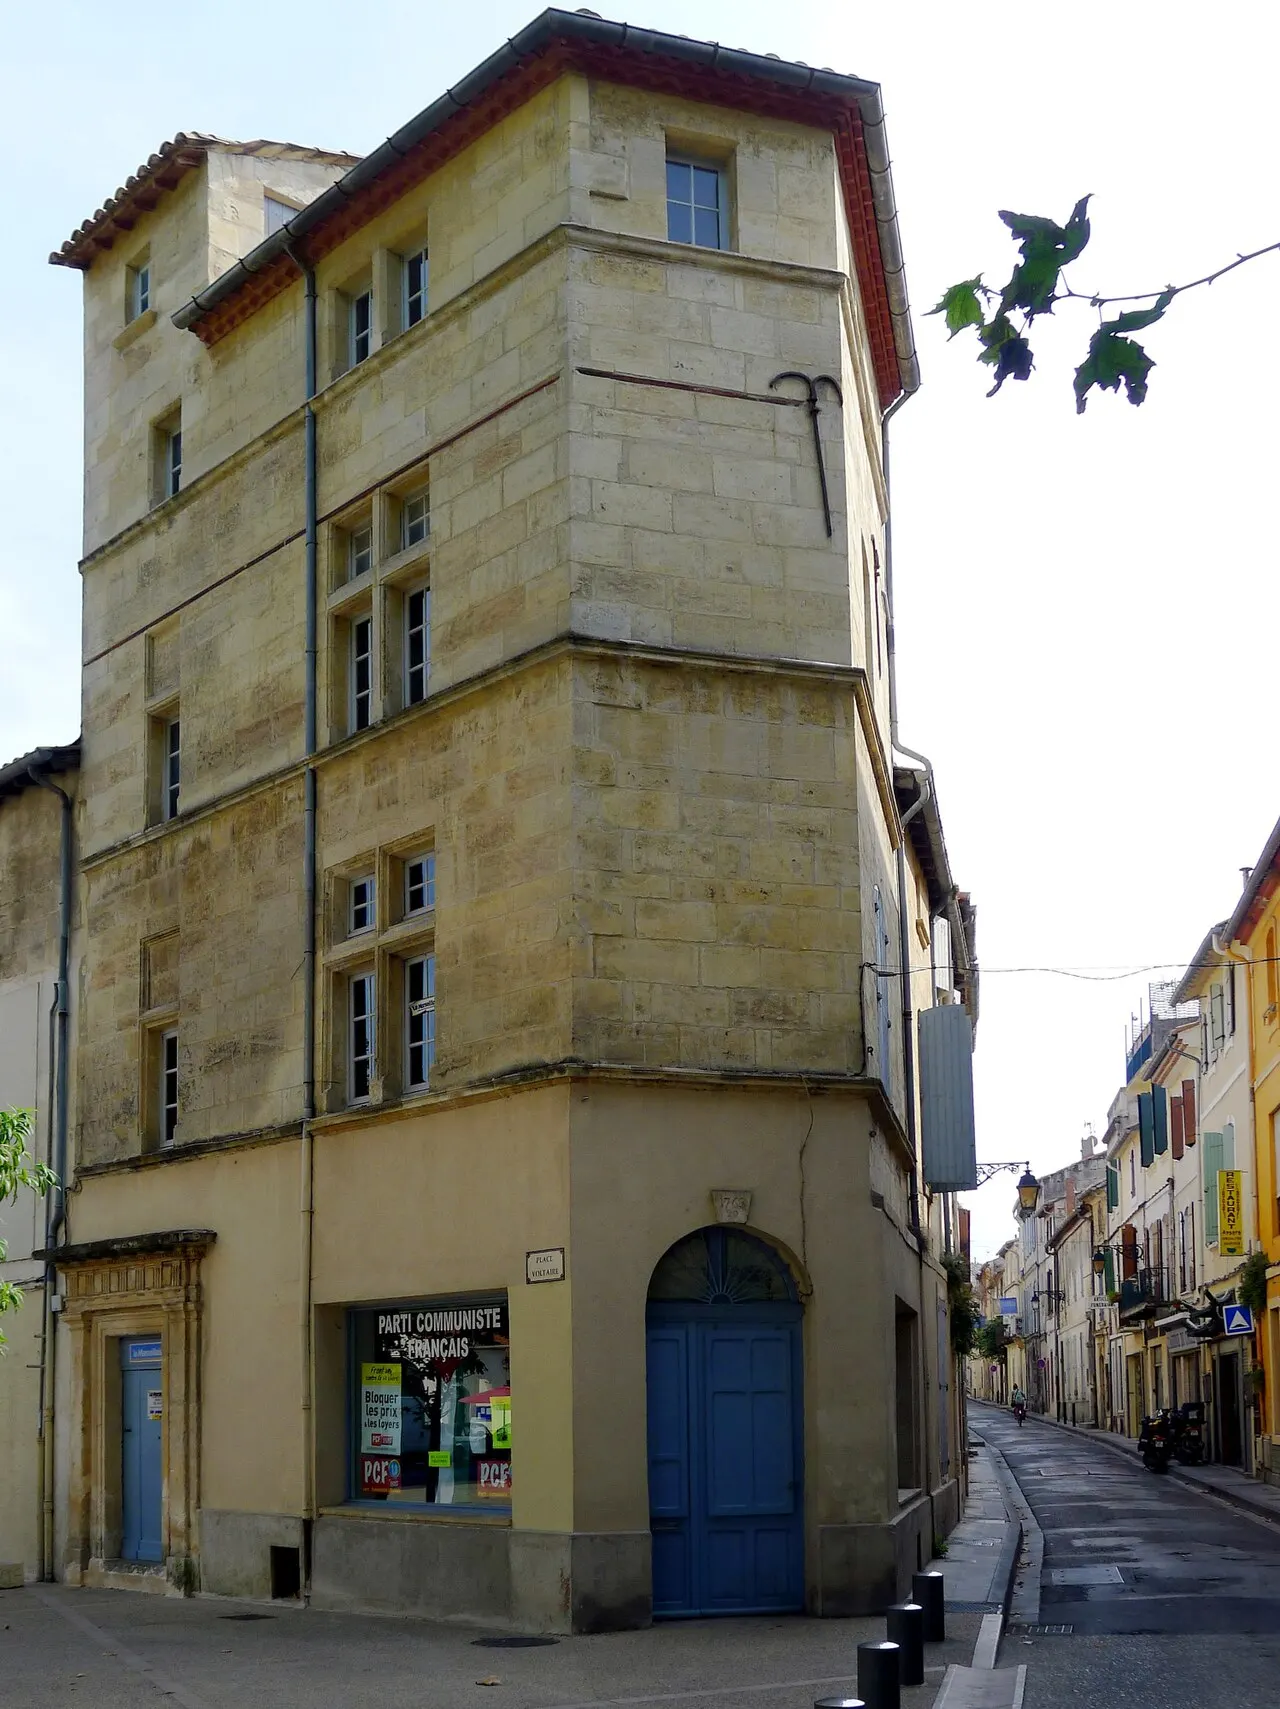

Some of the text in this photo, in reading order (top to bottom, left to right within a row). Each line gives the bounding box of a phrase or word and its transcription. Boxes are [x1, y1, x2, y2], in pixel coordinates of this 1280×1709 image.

[1226, 1172, 1236, 1229] RESTAURANT
[535, 1256, 553, 1264] PLACE
[531, 1268, 559, 1277] VOLTAIRE
[378, 1307, 501, 1335] PARTI COMMUNISTE
[408, 1336, 469, 1363] FRANÇAIS
[365, 1390, 399, 1407] Bloquer
[365, 1403, 398, 1419] les prix
[367, 1418, 377, 1428] les
[378, 1418, 400, 1430] loyers
[364, 1461, 389, 1484] PCF
[480, 1463, 509, 1488] PCF
